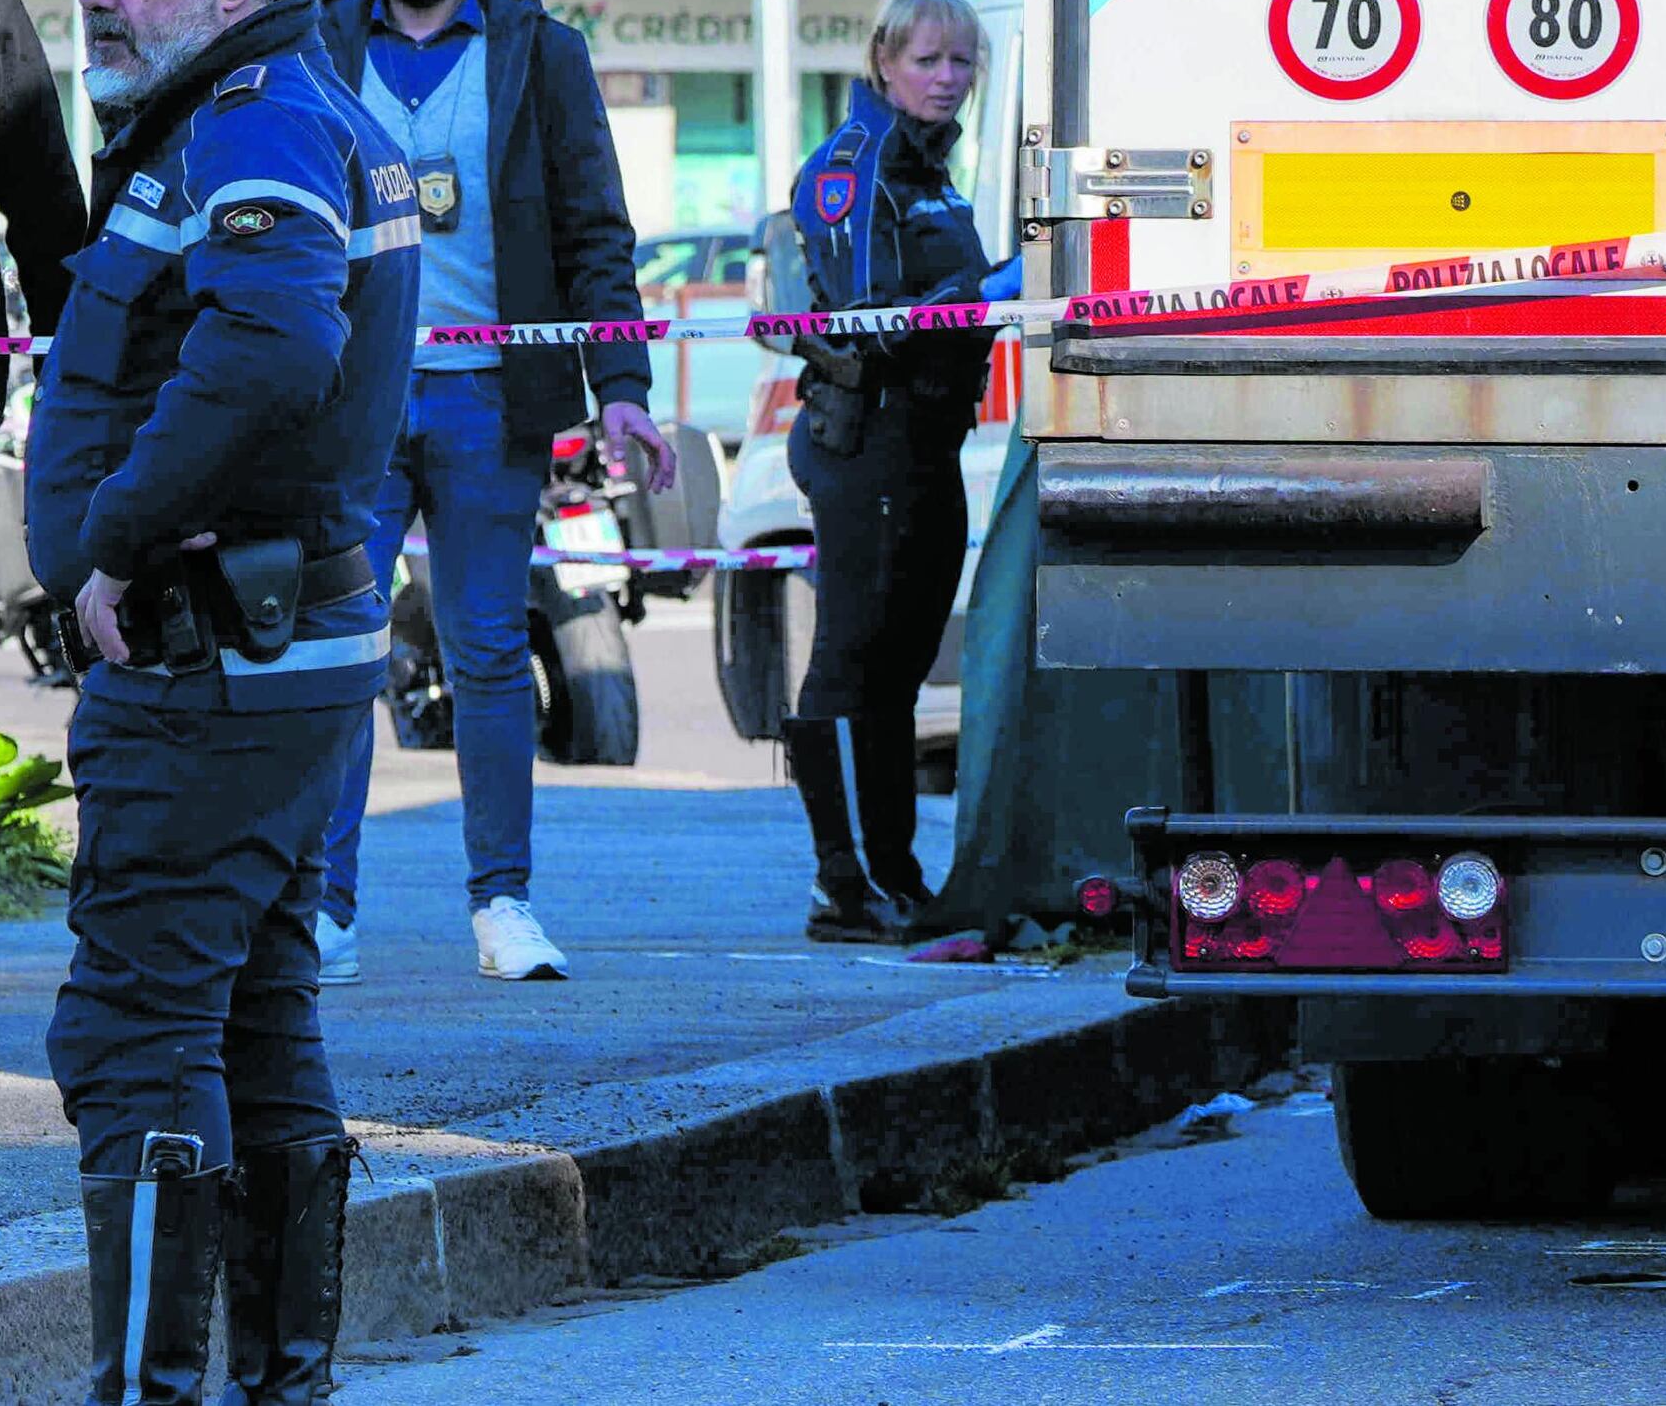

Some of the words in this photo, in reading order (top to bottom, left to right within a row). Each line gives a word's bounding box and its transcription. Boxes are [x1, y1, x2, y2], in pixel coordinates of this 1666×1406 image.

[370, 162, 416, 205] POLIZIA
[1394, 259, 1506, 292] POLIZIA
[1515, 245, 1621, 280] LOCALE
[1073, 294, 1186, 320] POLIZIA
[1195, 281, 1299, 311] LOCALE
